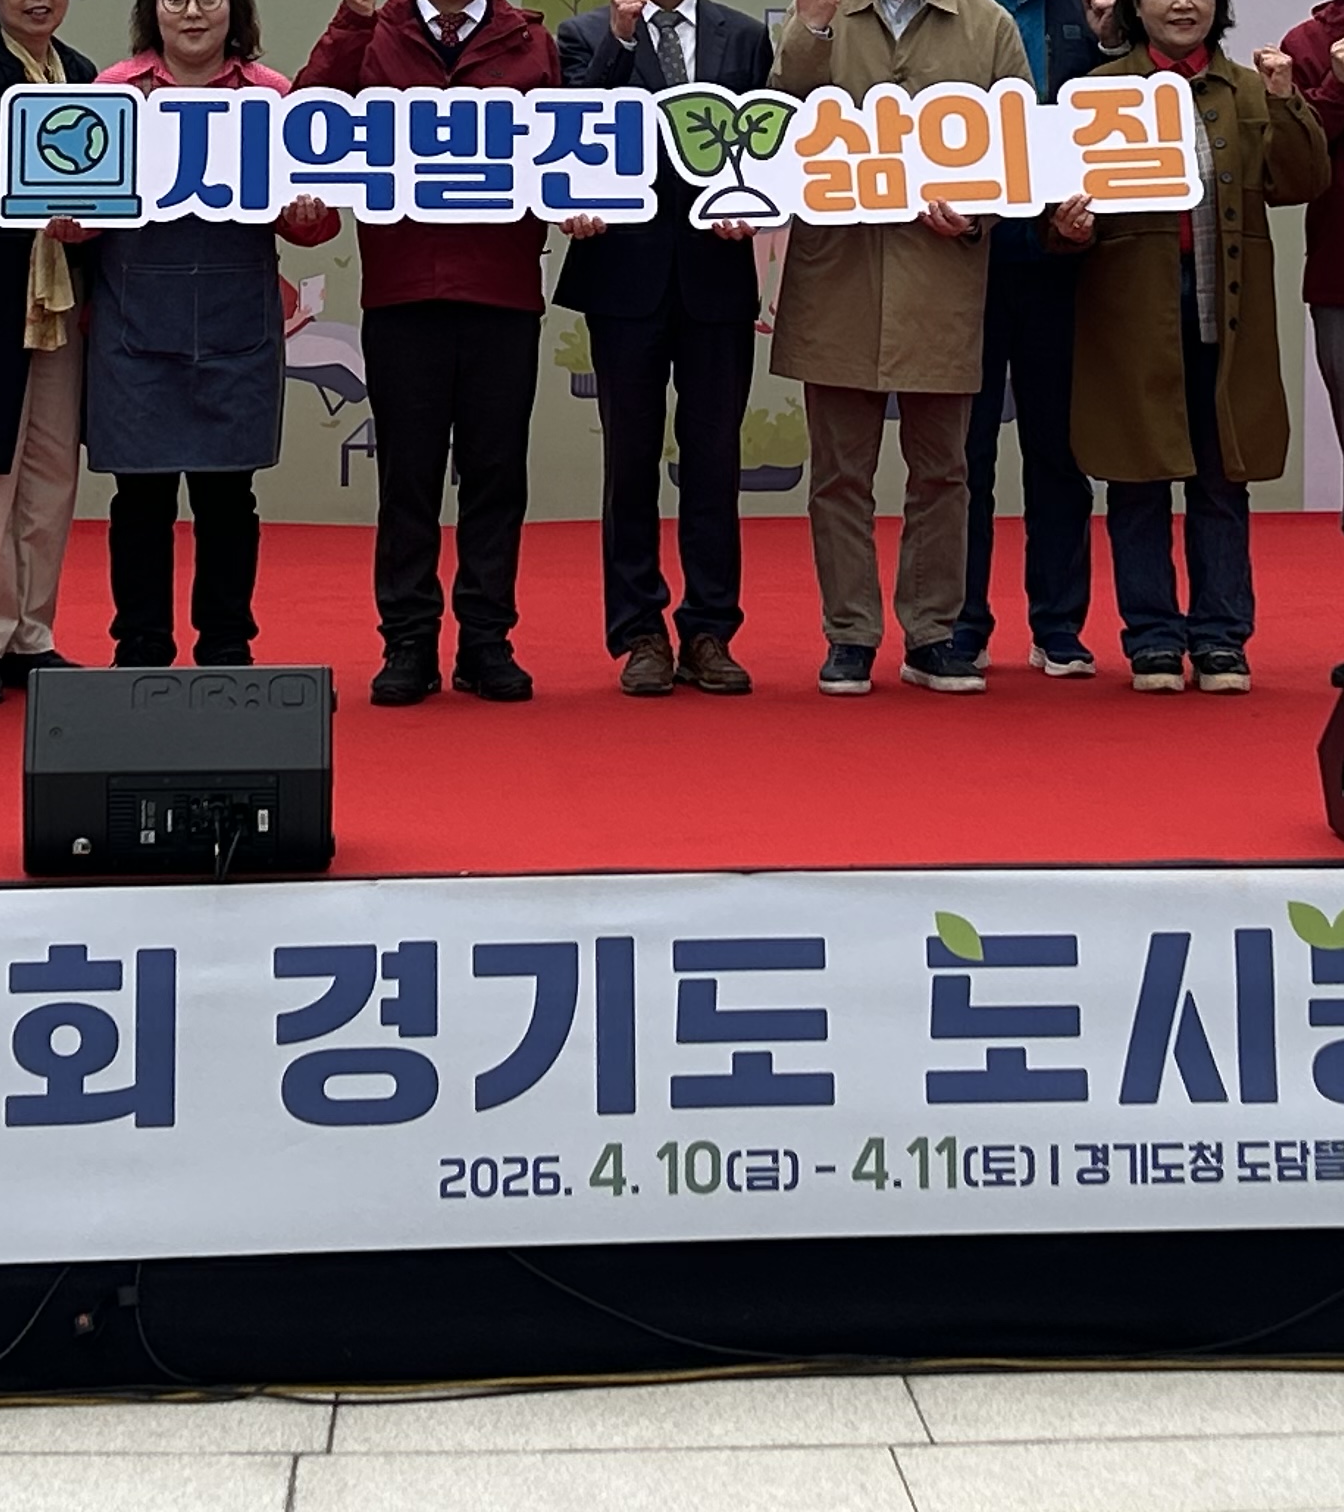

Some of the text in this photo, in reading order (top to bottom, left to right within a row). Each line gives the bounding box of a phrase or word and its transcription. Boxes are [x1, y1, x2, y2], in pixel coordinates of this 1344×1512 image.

[156, 99, 645, 211] 지역발전
[794, 83, 1191, 213] 삶의 질
[273, 936, 836, 1128] 경기도
[439, 1155, 573, 1199] 2026.
[656, 1139, 800, 1195] 10(금)
[851, 1135, 1036, 1190] 4.11(토)
[1073, 1141, 1224, 1185] 경기도청
